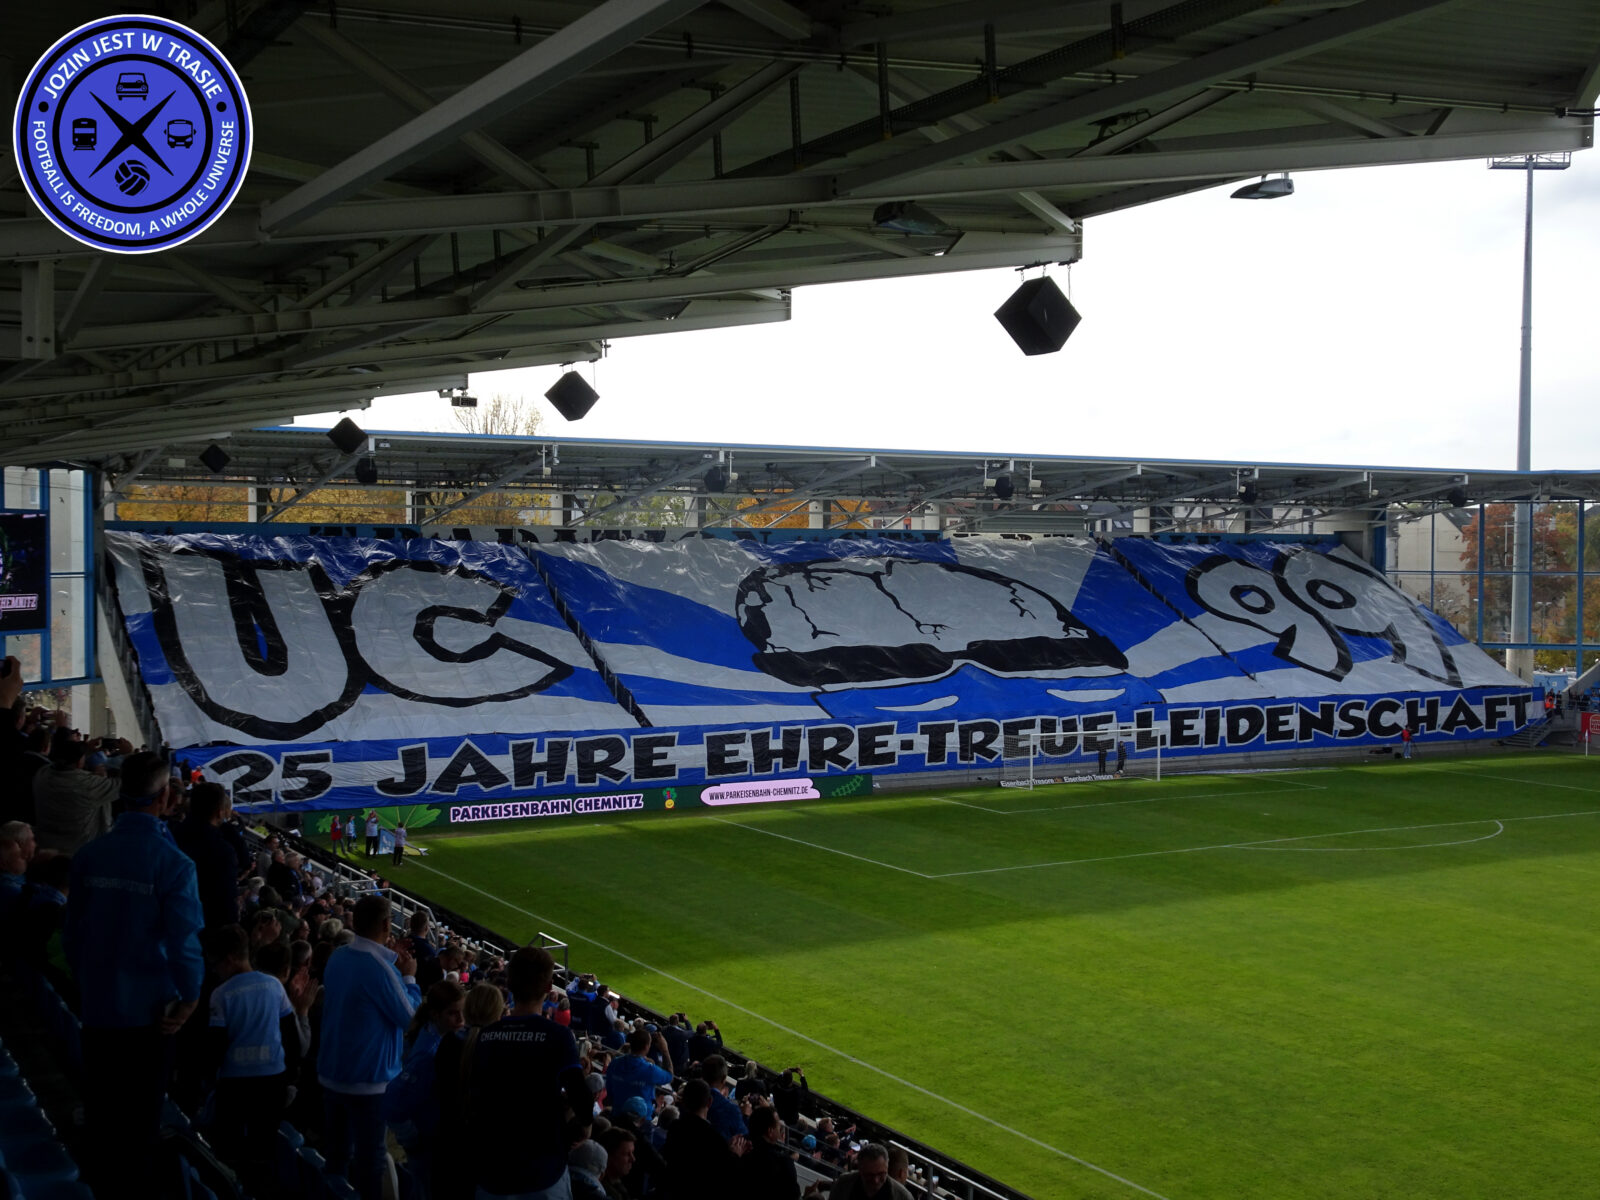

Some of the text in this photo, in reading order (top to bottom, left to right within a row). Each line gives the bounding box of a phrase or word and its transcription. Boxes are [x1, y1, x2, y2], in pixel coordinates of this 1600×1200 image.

[204, 749, 334, 805] 25
[374, 732, 681, 798] JAHRE
[708, 786, 809, 801] WWW.PARKEISENBAHN-CHEMNITZ.DE
[451, 794, 644, 822] PARKEISENBAHN CHEMNITZ
[480, 1031, 546, 1042] CHEMNITZER FC
